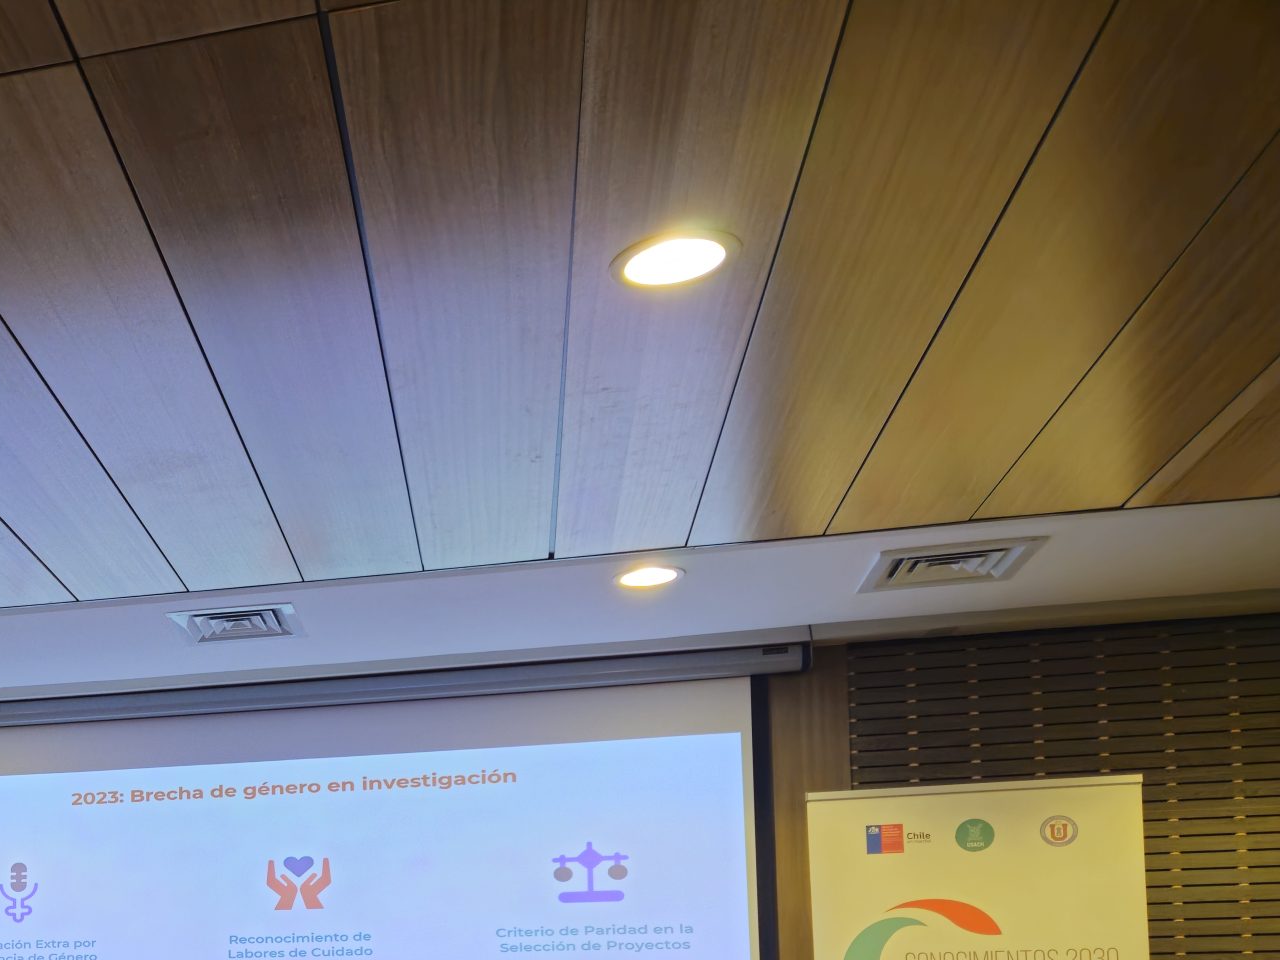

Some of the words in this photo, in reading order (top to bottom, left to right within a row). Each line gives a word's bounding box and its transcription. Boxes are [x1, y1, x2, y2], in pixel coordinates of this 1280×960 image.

[71, 790, 124, 806] 2023:
[130, 787, 204, 803] Brecha
[210, 785, 237, 798] de
[243, 782, 321, 800] género
[327, 780, 355, 792] en
[362, 769, 517, 790] investigación
[906, 832, 931, 840] Chile
[495, 926, 554, 938] Criterio
[559, 926, 579, 936] de
[584, 924, 648, 935] Paridad
[653, 925, 674, 934] en
[679, 923, 694, 934] la
[229, 933, 349, 944] Reconocimiento
[352, 931, 372, 941] de
[35, 939, 70, 949] Extra
[73, 939, 97, 950] por
[499, 941, 576, 953] Selección
[581, 940, 601, 950] de
[607, 939, 691, 952] Proyectos
[227, 948, 285, 959] Labores
[288, 948, 307, 957] de
[311, 946, 374, 957] Cuidado
